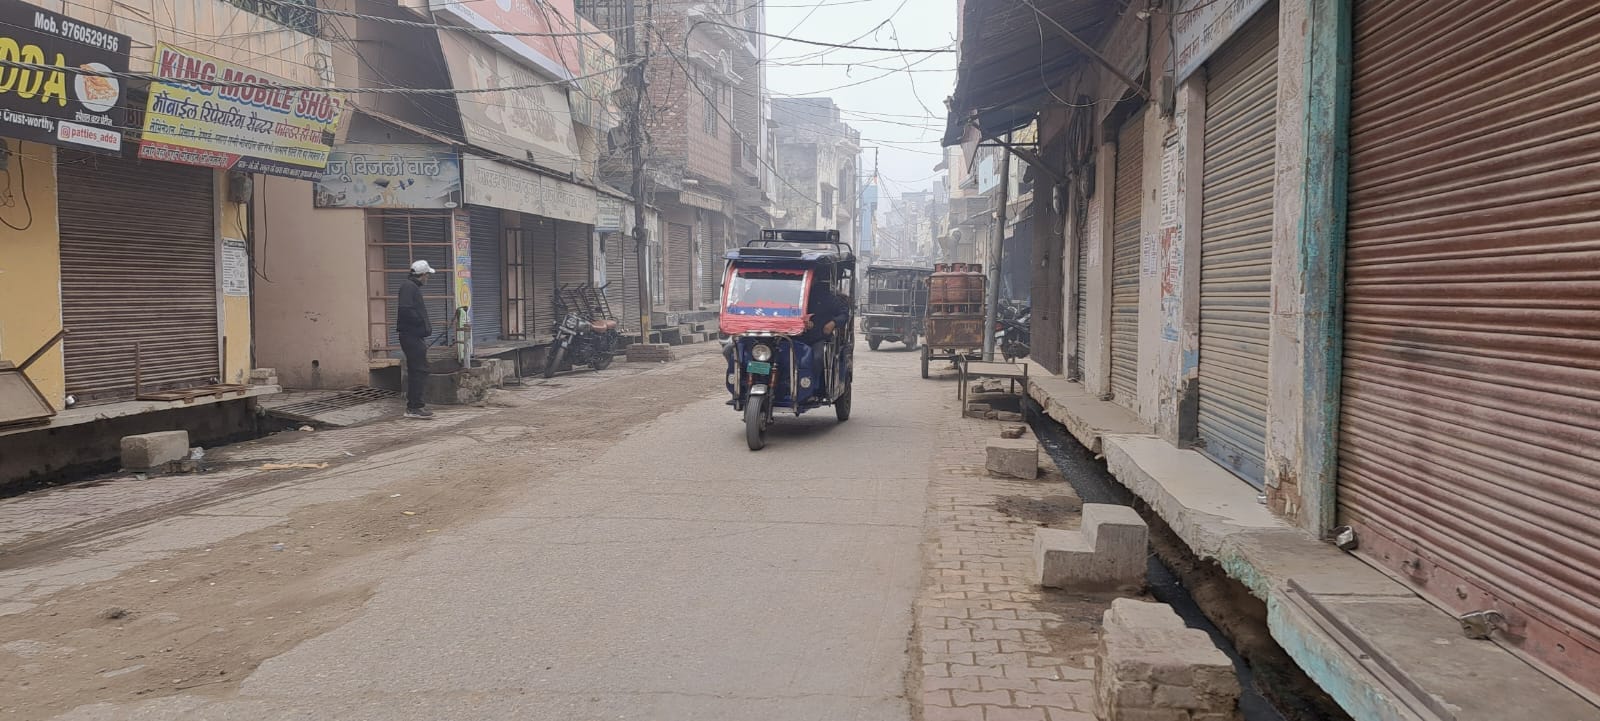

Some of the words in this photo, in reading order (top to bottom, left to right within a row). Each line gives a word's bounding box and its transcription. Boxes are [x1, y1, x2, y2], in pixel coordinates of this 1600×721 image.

[34, 12, 59, 34] Mob.
[61, 20, 119, 52] 9760529156
[159, 50, 217, 91] KING
[220, 68, 294, 110] MOBILE
[3, 110, 54, 133] Crust-worthy.
[71, 128, 117, 144] patties_adda
[407, 157, 441, 177] वाले
